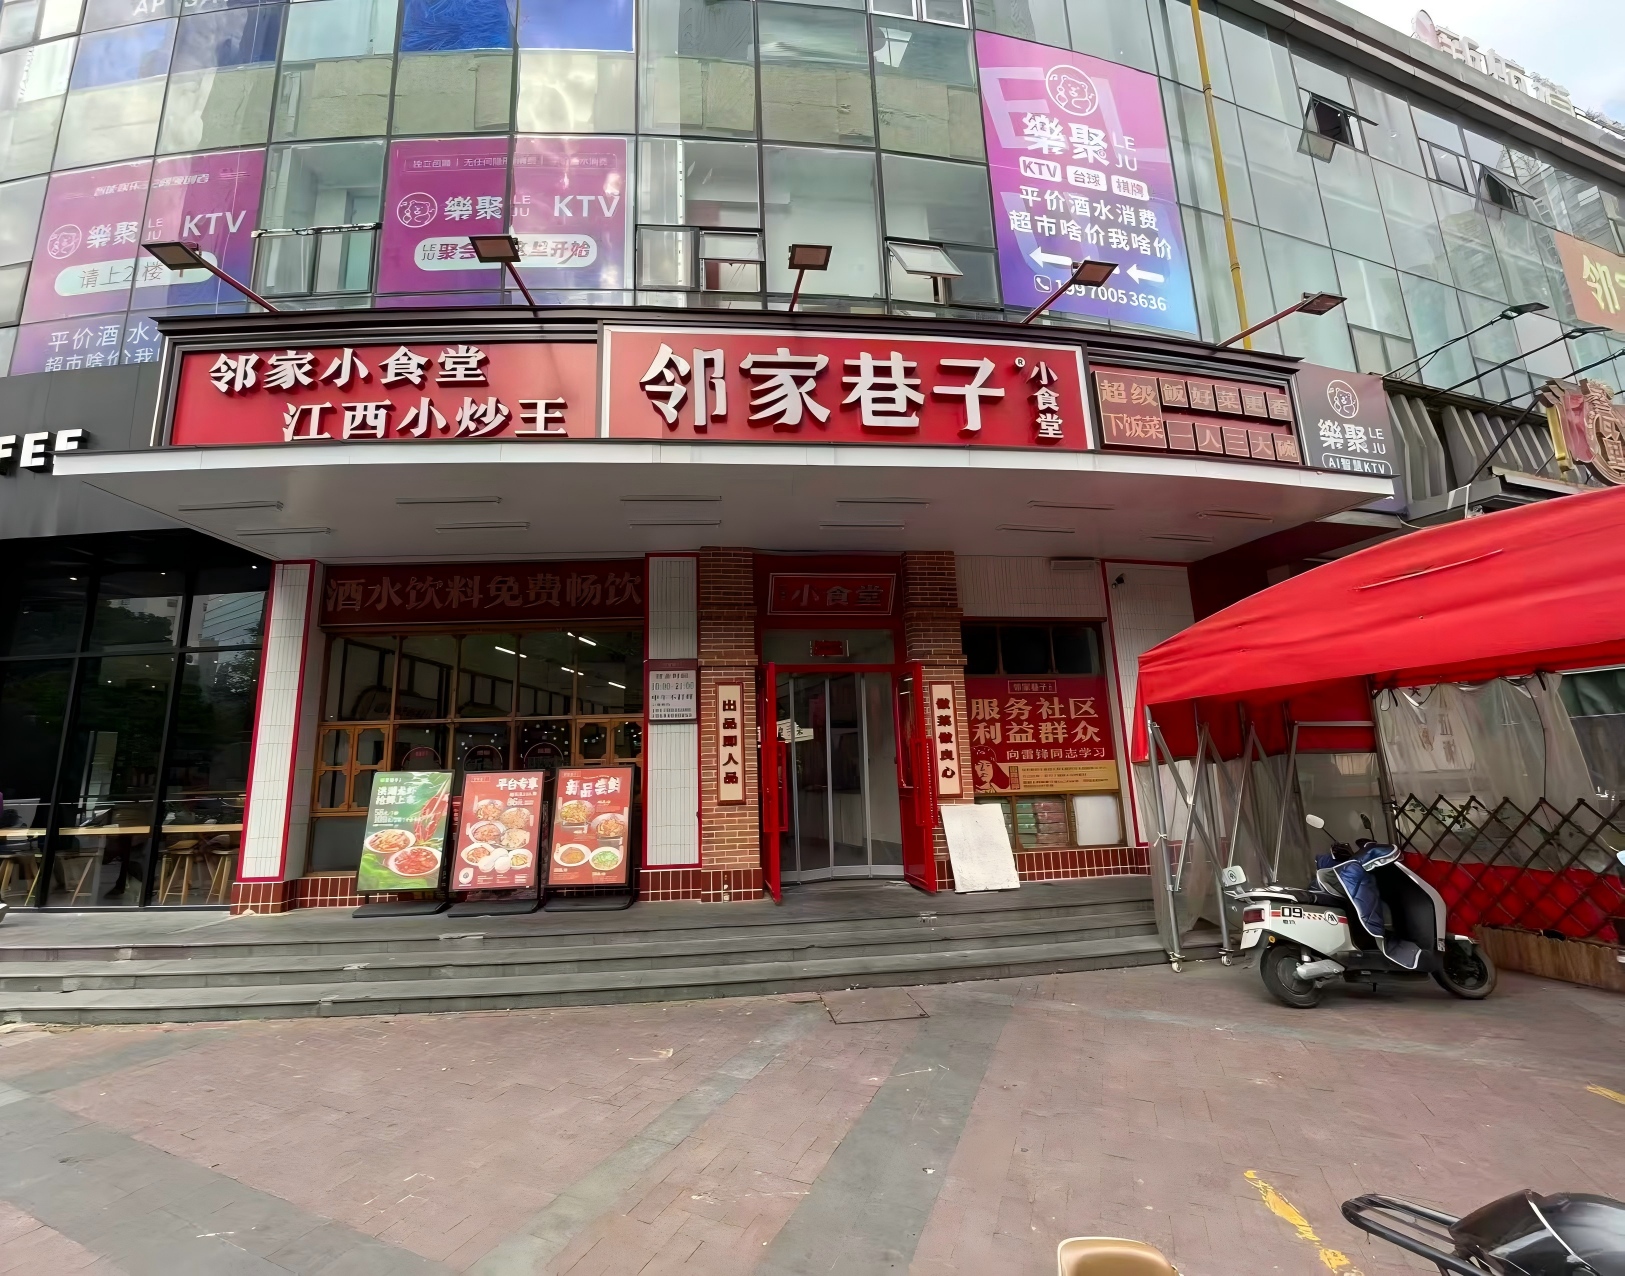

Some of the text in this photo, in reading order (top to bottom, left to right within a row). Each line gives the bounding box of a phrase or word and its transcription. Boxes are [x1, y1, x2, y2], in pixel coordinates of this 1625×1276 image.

[1022, 160, 1058, 178] KTV
[444, 195, 503, 221] 樂聚
[554, 195, 621, 218] KTV
[1019, 185, 1159, 232] 平价酒水消费
[183, 210, 247, 238] KTV
[1008, 209, 1172, 261] 超市啥价我啥价
[1583, 254, 1625, 314] 邻
[48, 321, 162, 352] 平价酒水
[45, 347, 160, 373] 超市啥价我
[209, 344, 489, 394] 邻家小食堂
[639, 342, 1005, 431] 邻家巷子
[1027, 361, 1065, 438] 小食堂
[1100, 379, 1159, 408] 超级
[282, 396, 569, 442] 江西小炒王
[1102, 413, 1164, 440] 下饭菜
[1170, 425, 1298, 459] 一人三大碗
[1317, 418, 1385, 453] 樂聚 LE
[1372, 443, 1387, 455] JU
[325, 571, 642, 613] 酒水饮料免费畅饮
[970, 696, 1099, 721] 服务社区
[972, 720, 1101, 745] 利益群众
[1282, 907, 1303, 919] 09
